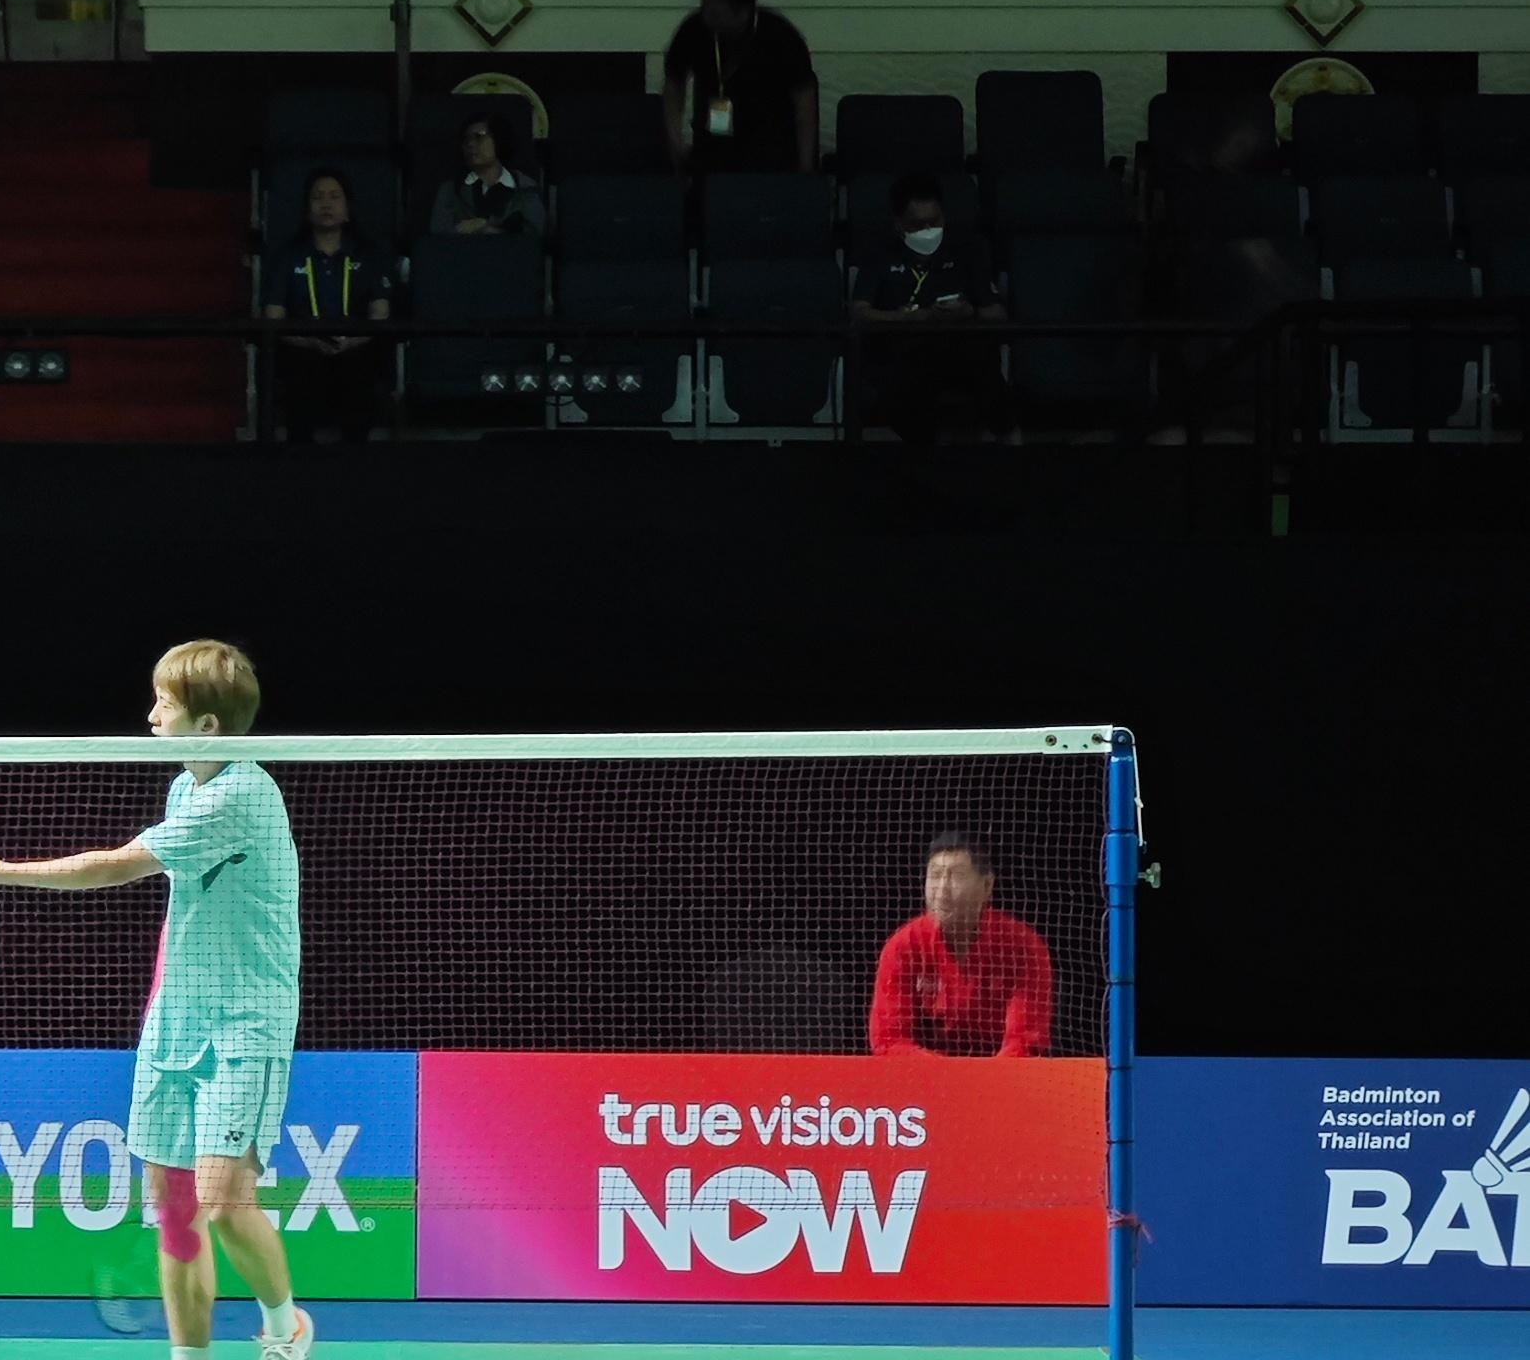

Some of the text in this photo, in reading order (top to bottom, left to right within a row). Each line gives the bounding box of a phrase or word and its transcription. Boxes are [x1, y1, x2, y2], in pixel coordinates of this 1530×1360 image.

[1322, 1086, 1441, 1104] Badminton
[598, 1093, 927, 1147] true visions
[1319, 1109, 1476, 1127] Association of
[1318, 1132, 1411, 1150] Thailand
[598, 1166, 927, 1274] NOW
